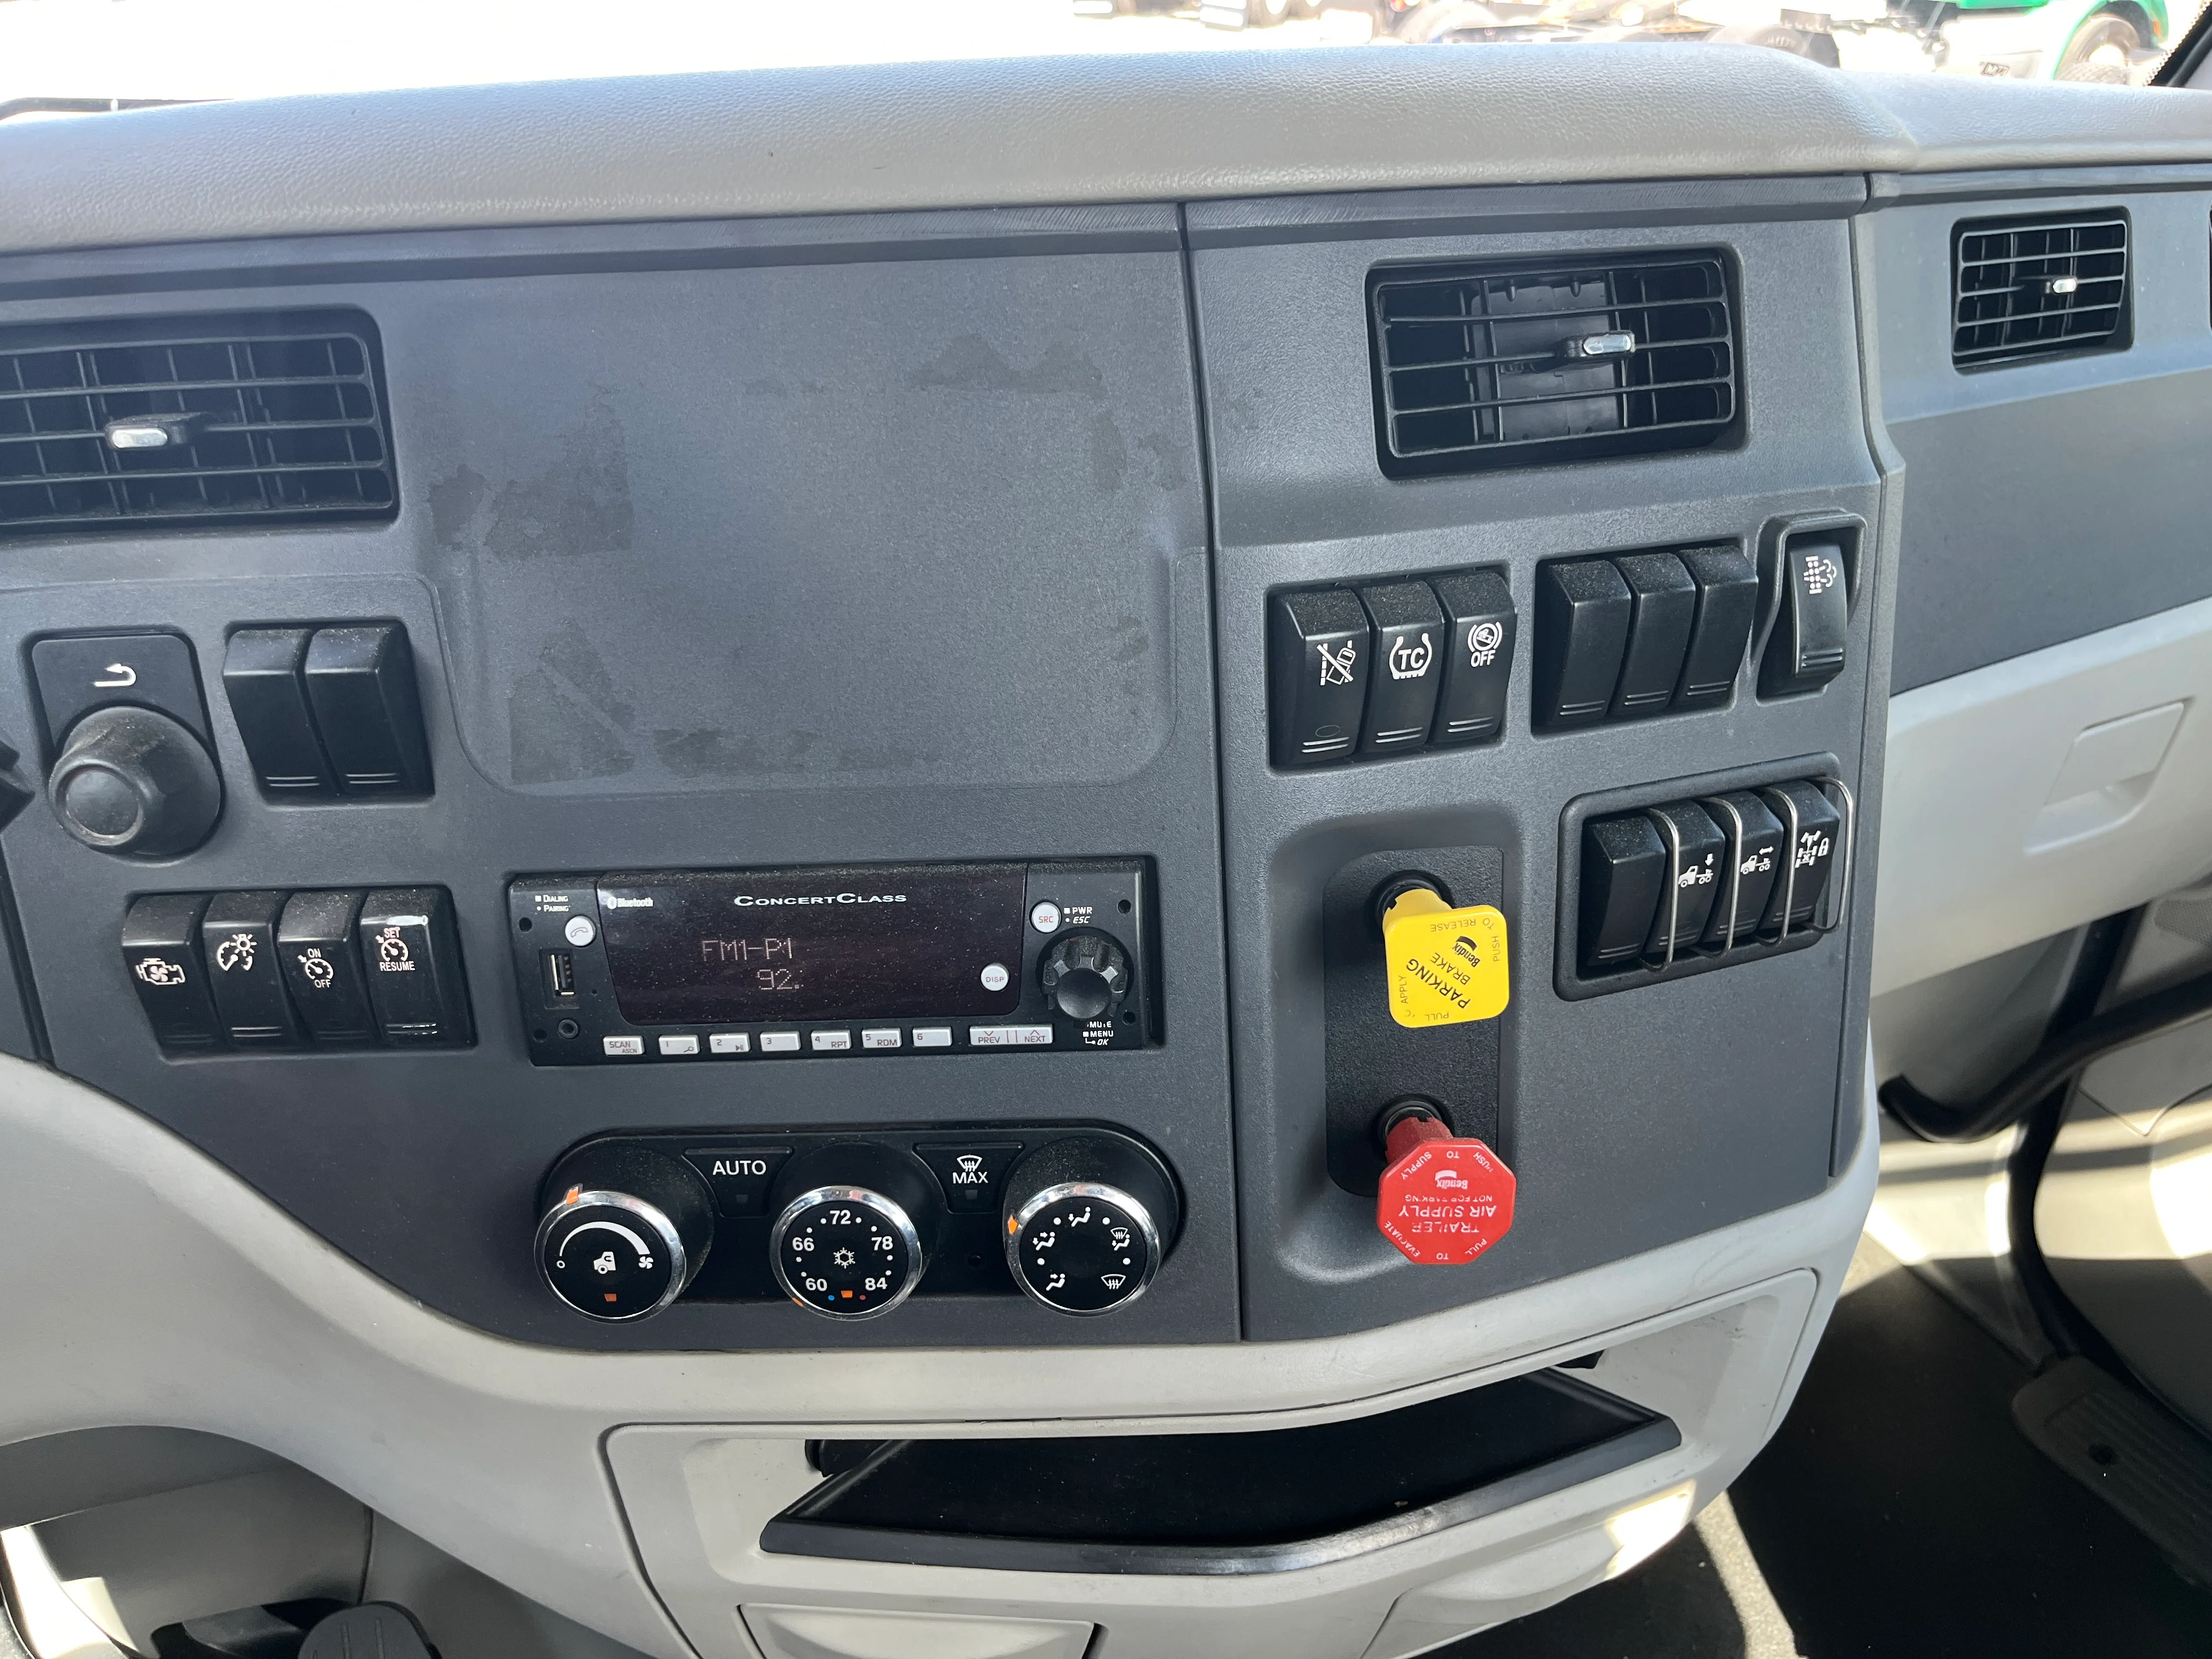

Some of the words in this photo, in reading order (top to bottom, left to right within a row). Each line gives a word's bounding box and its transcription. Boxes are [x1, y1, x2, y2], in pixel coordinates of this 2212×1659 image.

[1398, 648, 1425, 670] TC
[1470, 650, 1496, 668] OFF
[617, 897, 653, 907] Bluetooth
[1072, 906, 1093, 915] PWR
[1073, 916, 1091, 924] ESC
[1430, 918, 1476, 932] RELEASE
[1482, 918, 1494, 930] TO
[384, 927, 400, 938] SET
[307, 948, 321, 958] ON
[701, 938, 792, 961] FM1-P1
[1452, 943, 1480, 967] Bendix
[1492, 935, 1500, 961] PUSH
[379, 961, 415, 972] RESUME
[1430, 952, 1471, 985] BRAKE
[314, 979, 331, 988] OFF
[1399, 975, 1408, 1003] APPLY
[1406, 958, 1471, 1008] PARKING
[1425, 1012, 1449, 1020] PULL
[713, 1160, 766, 1176] AUTO
[1401, 1152, 1432, 1180] SUPPLY
[952, 1172, 988, 1184] MAX
[1436, 1179, 1468, 1189] Bendix
[830, 1209, 851, 1224] 72
[1399, 1205, 1464, 1217] SUPPLY
[1470, 1205, 1497, 1217] AIR
[792, 1237, 815, 1251] 66
[871, 1236, 893, 1251] 78
[1384, 1221, 1421, 1257] EVACUATE
[1465, 1238, 1487, 1255] PULL
[805, 1278, 827, 1291] 60
[865, 1277, 888, 1291] 84
